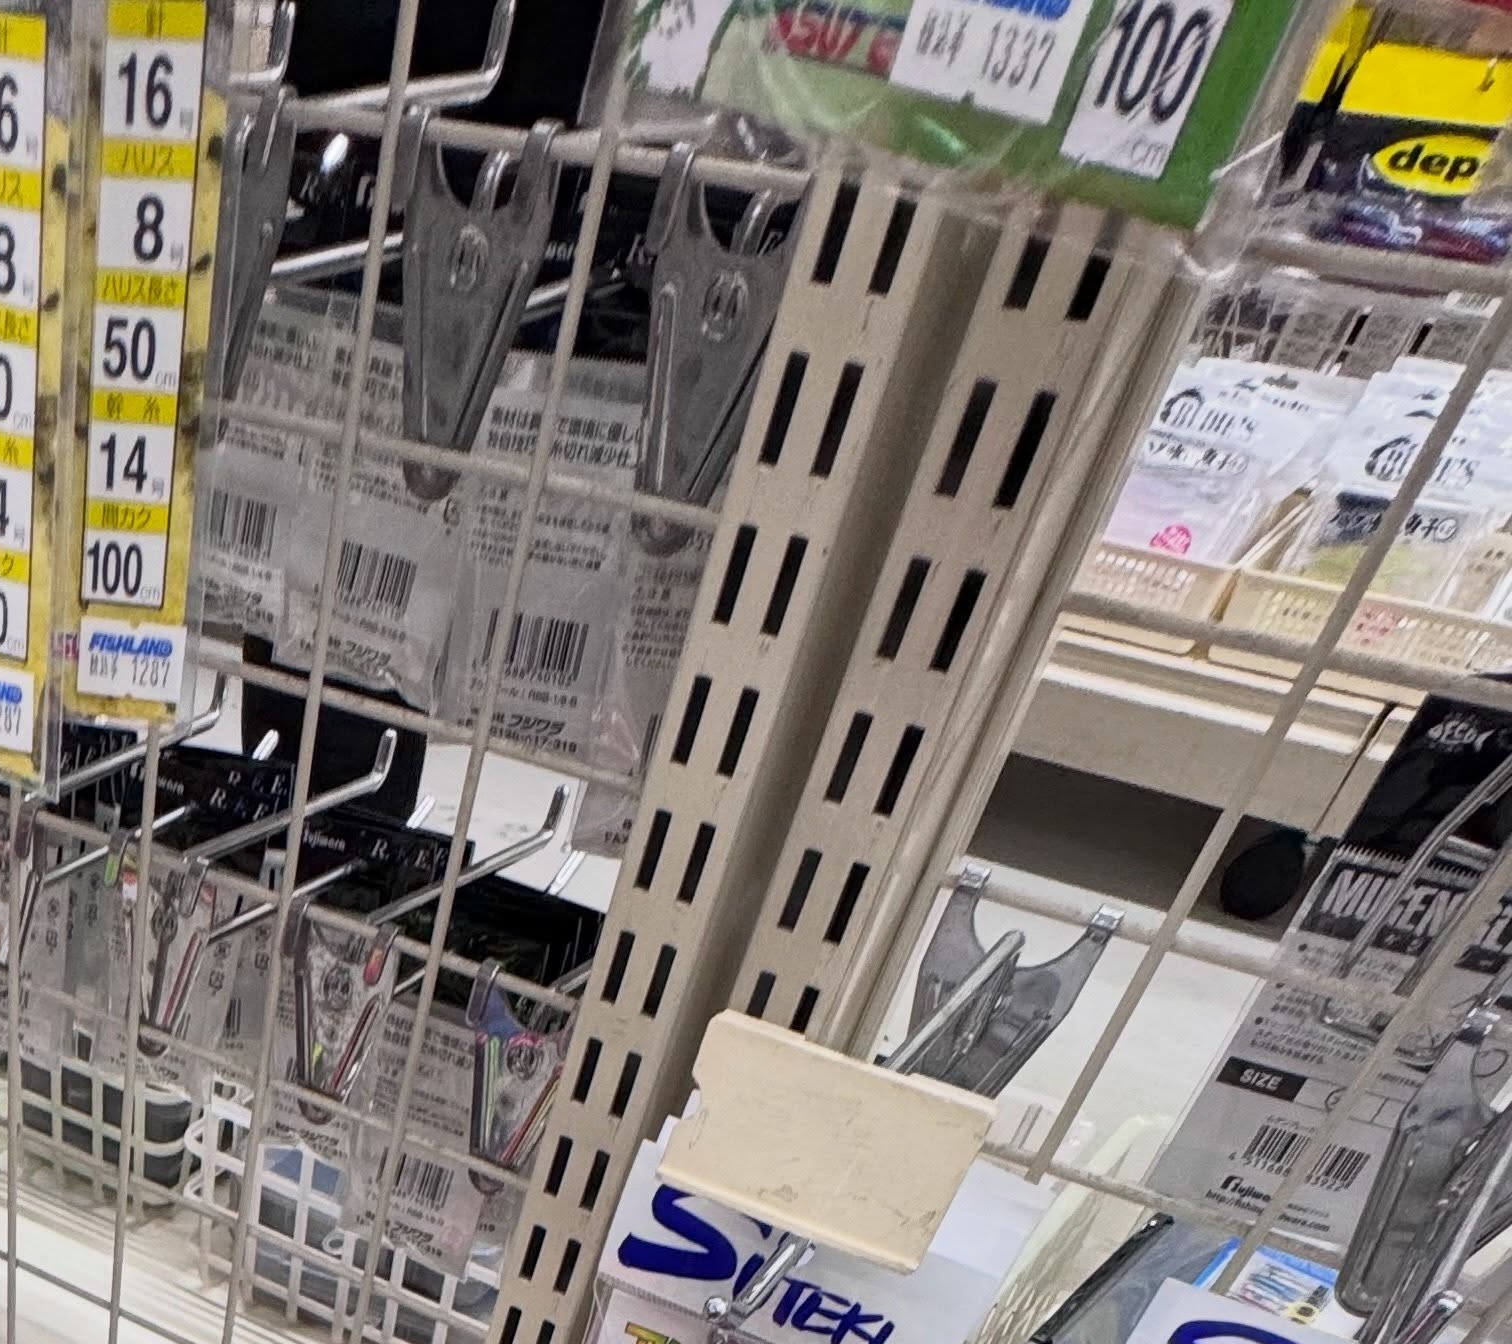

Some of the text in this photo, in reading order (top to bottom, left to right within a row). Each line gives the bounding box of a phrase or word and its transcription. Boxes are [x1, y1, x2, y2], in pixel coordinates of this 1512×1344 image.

[981, 17, 1057, 94] 1337
[1093, 1, 1214, 125] 100
[117, 51, 174, 131] 16
[1387, 142, 1480, 184] dep
[133, 193, 165, 264] 8
[102, 313, 158, 381] 50
[100, 431, 149, 495] 14
[87, 538, 144, 597] 100
[88, 632, 174, 658] FISHLAND
[130, 657, 171, 689] 1287
[1239, 1067, 1284, 1092] SIZE
